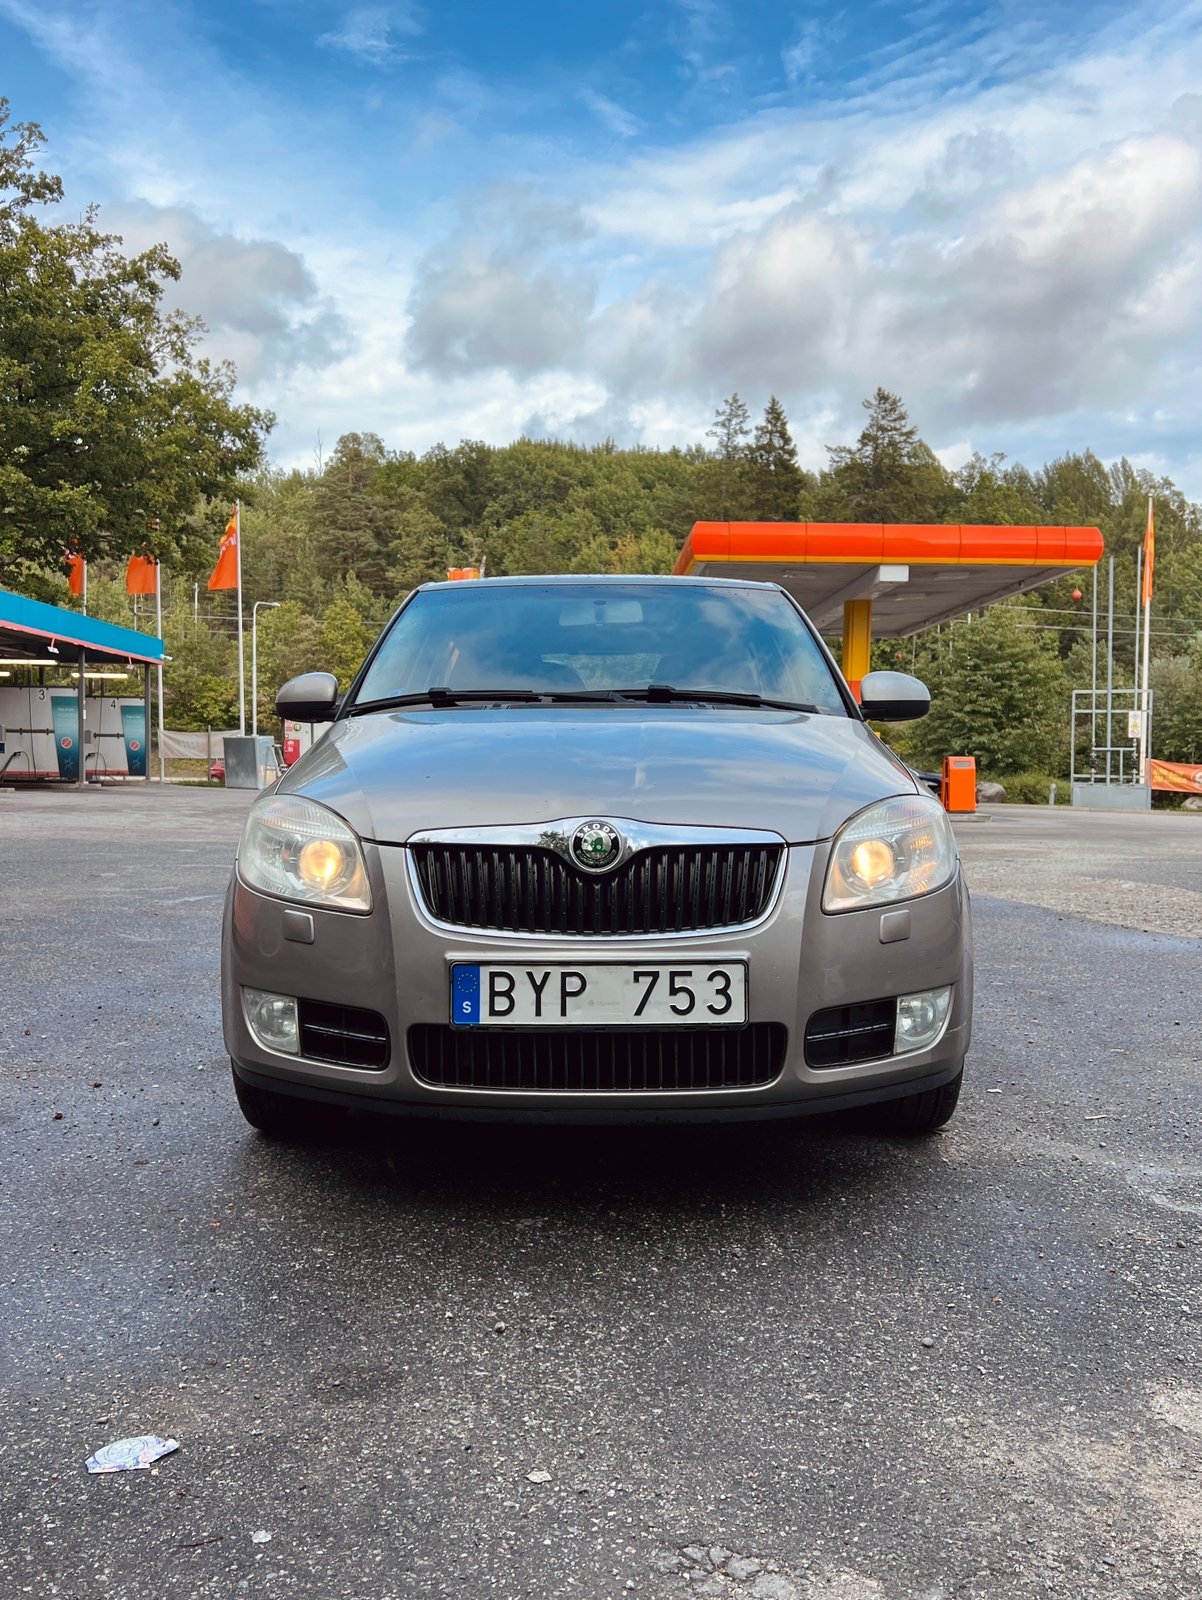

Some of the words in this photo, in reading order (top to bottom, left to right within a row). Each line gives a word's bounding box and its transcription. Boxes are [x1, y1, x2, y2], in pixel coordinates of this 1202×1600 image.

[39, 689, 46, 700] 3
[110, 700, 116, 709] 4
[488, 970, 587, 1017] BYP
[633, 970, 733, 1017] 753
[462, 1001, 472, 1013] S
